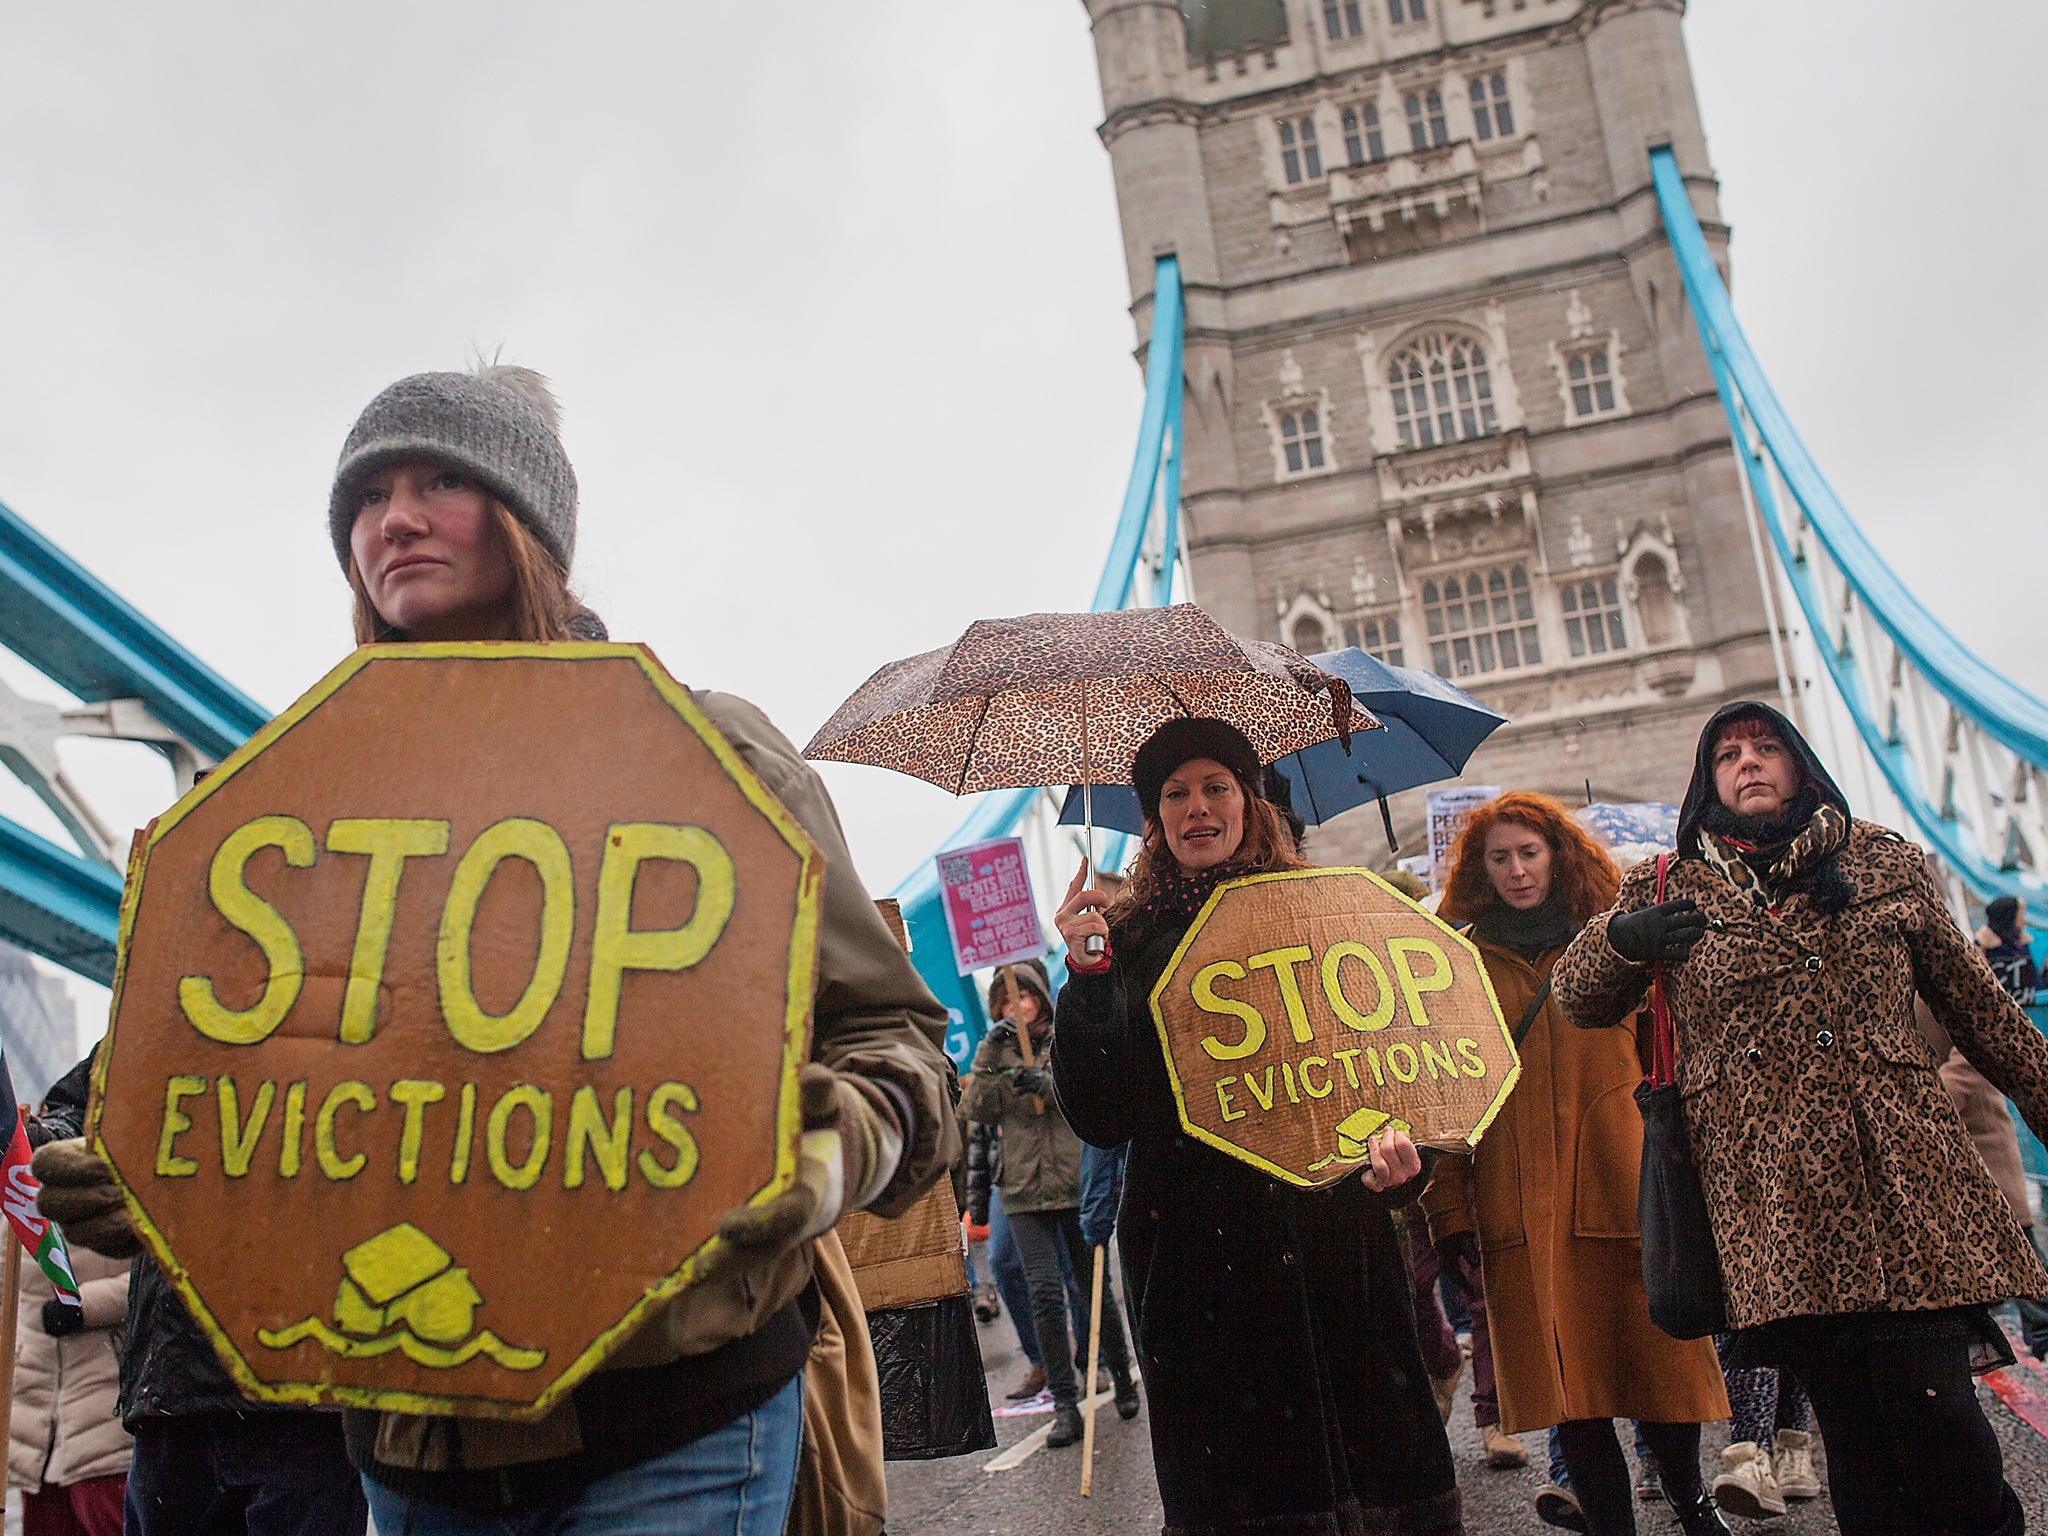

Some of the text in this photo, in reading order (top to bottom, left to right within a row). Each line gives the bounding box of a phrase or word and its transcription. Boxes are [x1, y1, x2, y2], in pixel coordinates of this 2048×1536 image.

[958, 875, 998, 902] RENTS
[997, 868, 1024, 889] NOT
[994, 854, 1019, 873] CAP
[970, 883, 1027, 913] BENEFITS
[994, 914, 1035, 939] PEOPLE
[178, 814, 736, 1059] STOP
[1190, 936, 1454, 1061] STOP
[1215, 1037, 1487, 1123] EVICTIONS
[155, 1075, 699, 1191] EVICTIONS
